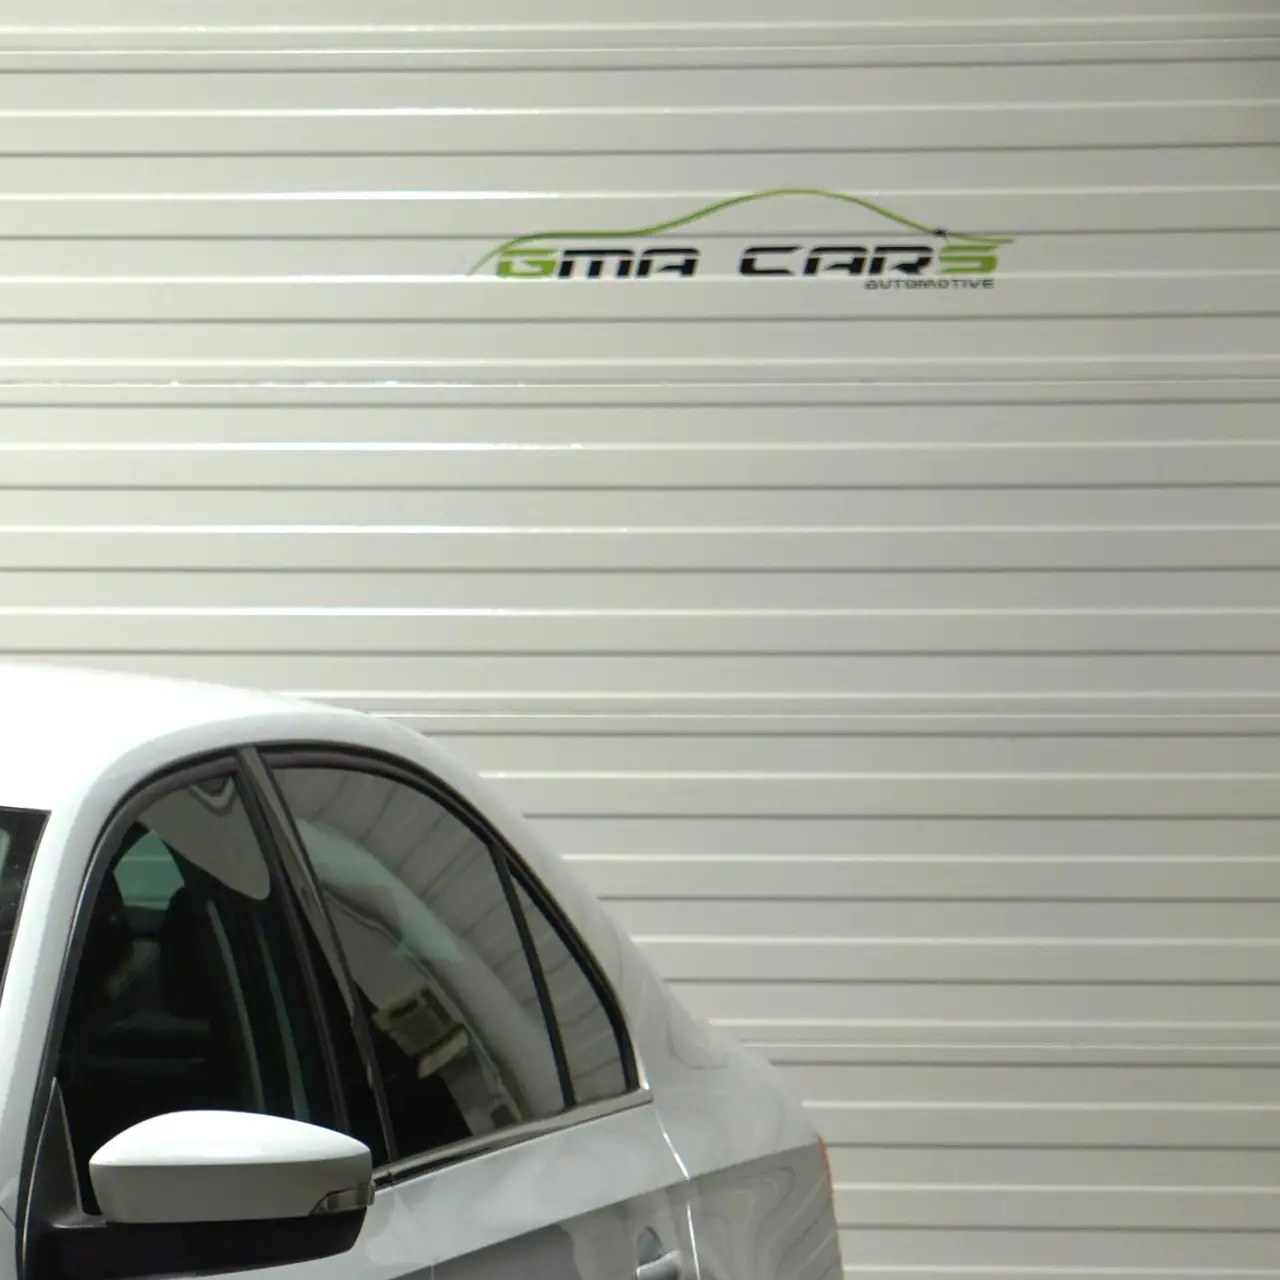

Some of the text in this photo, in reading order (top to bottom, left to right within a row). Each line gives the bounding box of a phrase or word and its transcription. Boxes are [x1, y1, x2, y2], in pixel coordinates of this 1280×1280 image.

[496, 245, 998, 278] GMA CARS
[864, 278, 995, 290] AUTOMOTIVE
